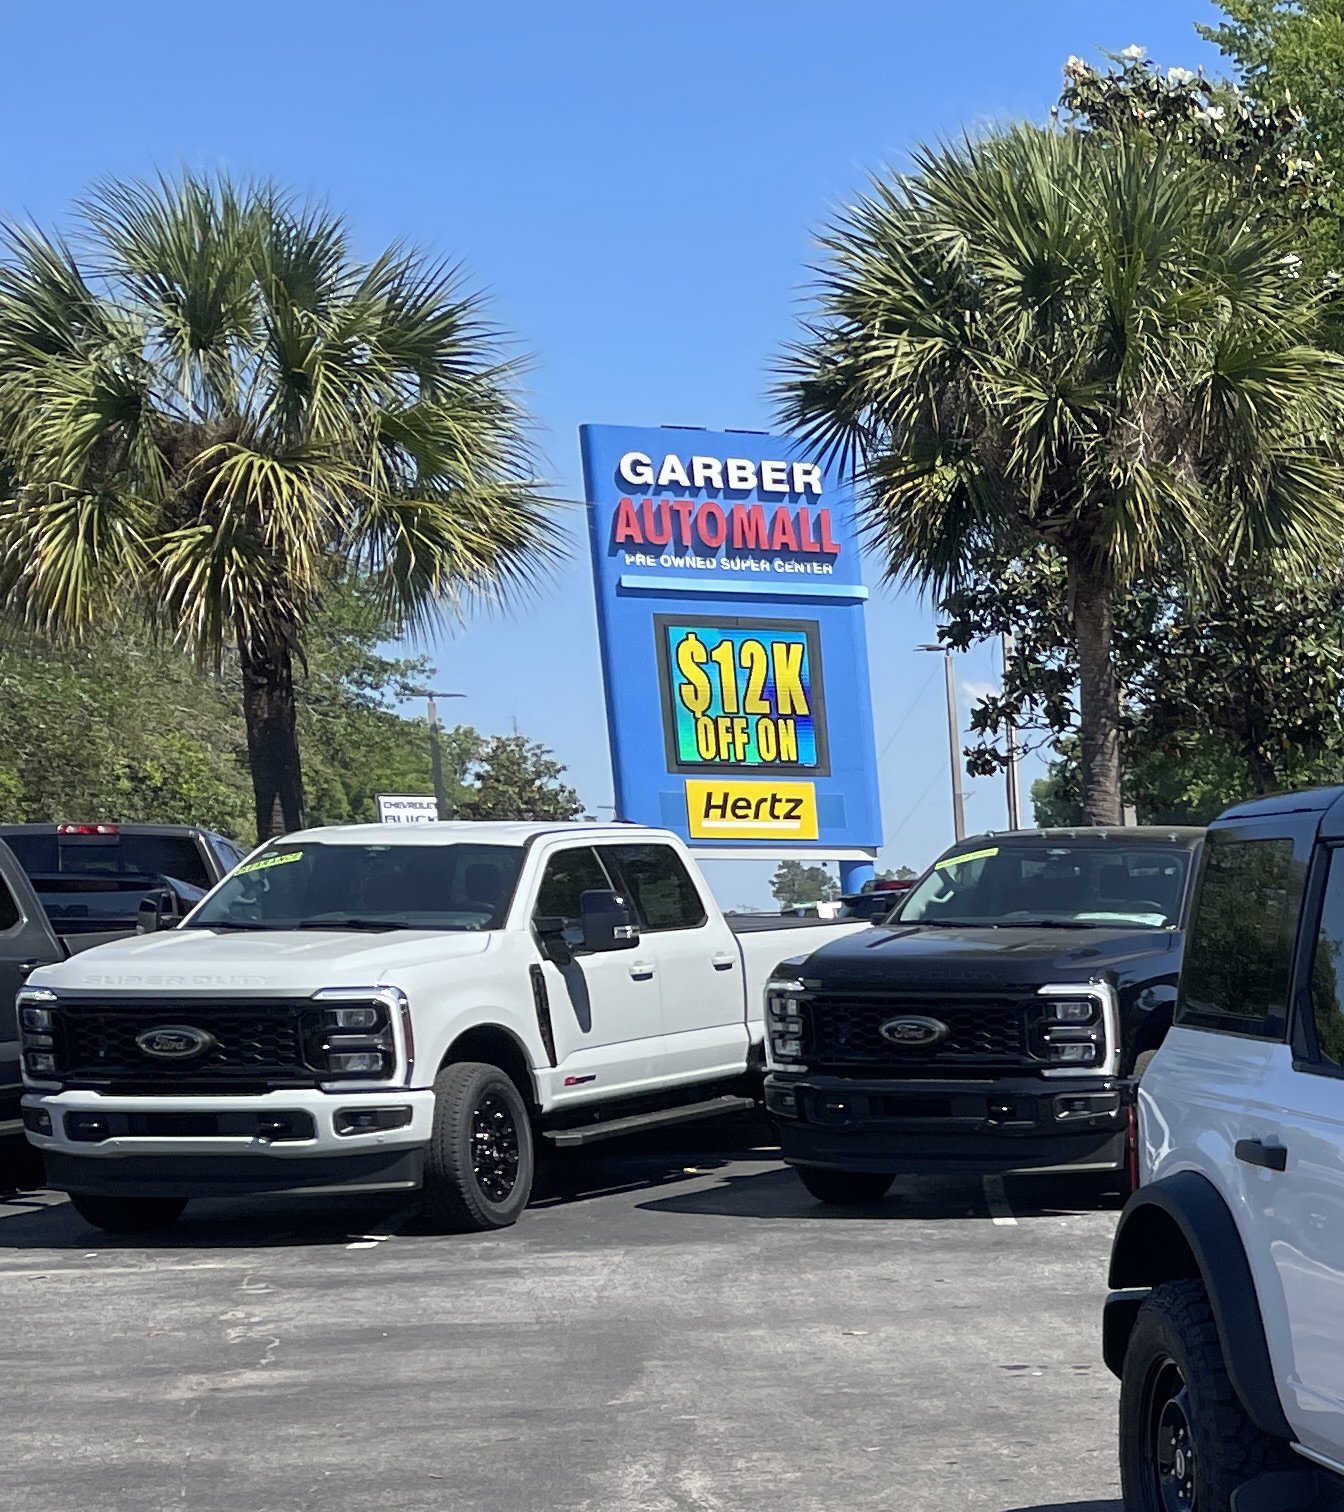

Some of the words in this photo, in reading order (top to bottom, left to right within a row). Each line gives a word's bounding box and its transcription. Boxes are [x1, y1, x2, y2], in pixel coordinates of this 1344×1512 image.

[619, 451, 823, 494] GARBER
[615, 496, 841, 552] AUTOMALL
[624, 552, 656, 567] PRE
[660, 554, 717, 570] OWNED
[720, 556, 770, 572] SUPER
[774, 560, 833, 575] CENTER
[677, 632, 810, 719] $12K
[697, 715, 748, 760] OFF
[756, 716, 798, 762] ON
[703, 791, 804, 820] Hertz
[153, 1034, 187, 1050] Ford
